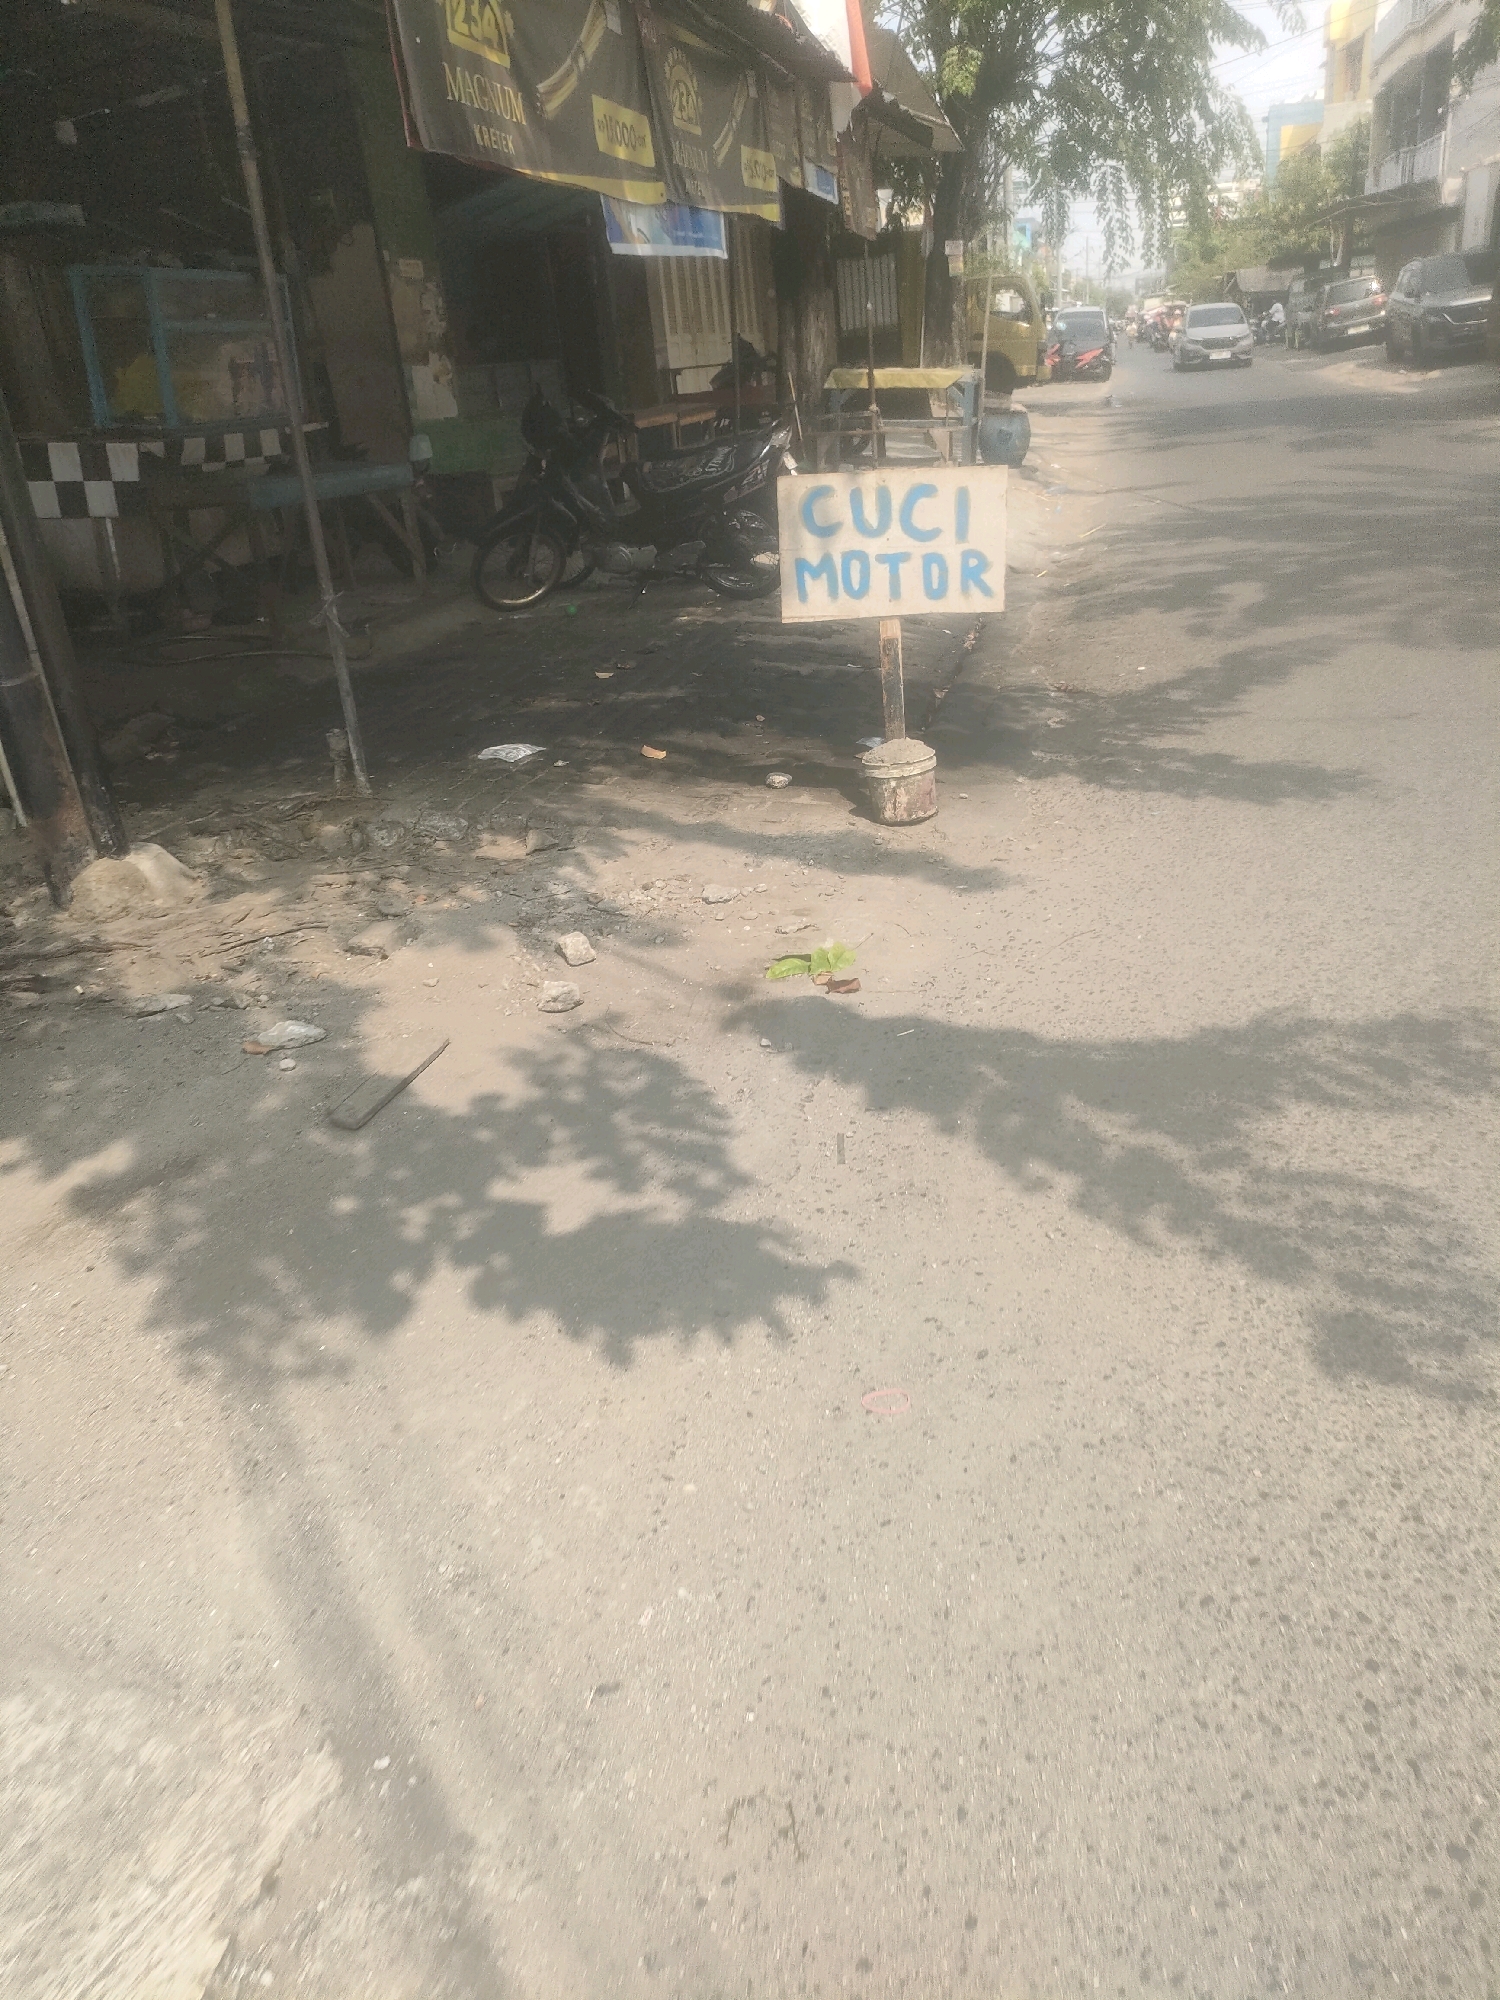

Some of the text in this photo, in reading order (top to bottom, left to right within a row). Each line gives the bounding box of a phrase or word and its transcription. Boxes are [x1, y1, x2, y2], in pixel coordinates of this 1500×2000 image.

[442, 61, 526, 126] MAGNUM
[473, 124, 516, 156] KRETEK
[802, 483, 971, 545] CUCI
[794, 549, 995, 603] MOTOR
